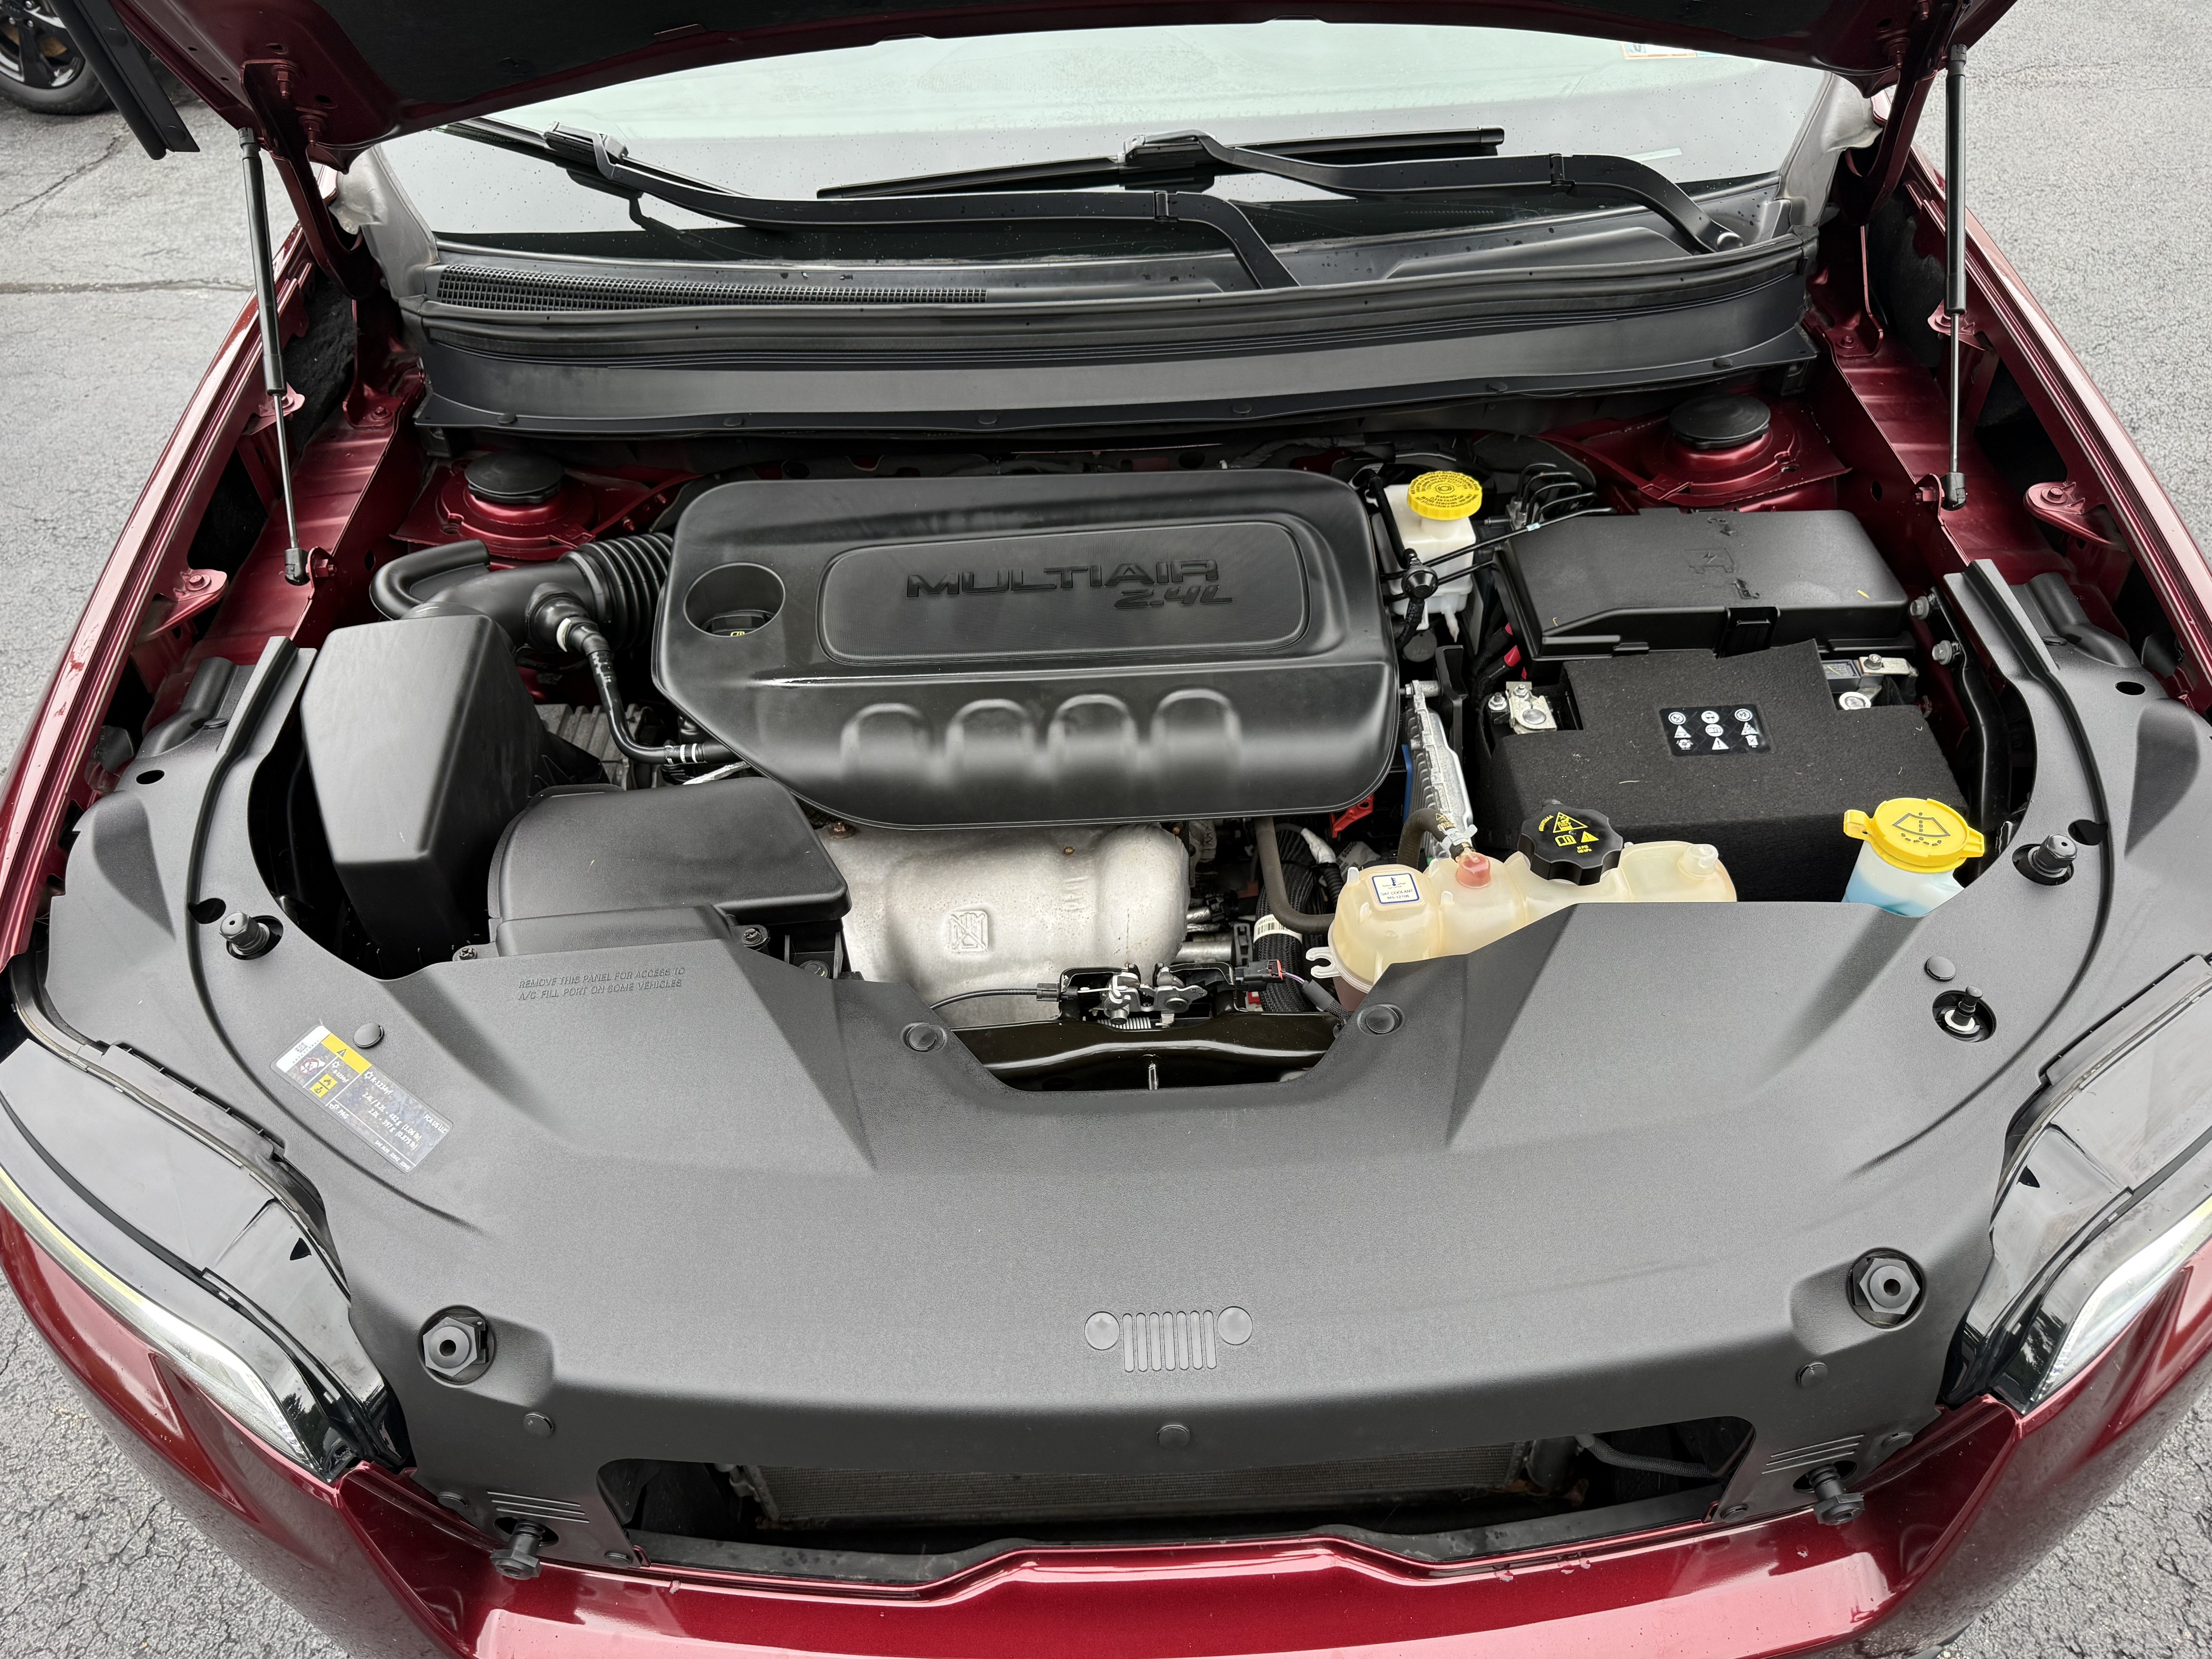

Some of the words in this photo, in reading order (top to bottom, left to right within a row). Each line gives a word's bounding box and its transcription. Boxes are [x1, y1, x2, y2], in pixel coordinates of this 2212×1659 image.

[907, 559, 1219, 598] MULTIAIR
[1114, 584, 1233, 608] 2.4L
[519, 978, 557, 988] REMOVE
[560, 976, 580, 985] THIS
[582, 973, 611, 983] PANEL
[614, 972, 632, 980] FOR
[634, 969, 670, 979] ACCESS
[518, 991, 536, 1001] A/C
[541, 989, 559, 998] FILL
[563, 987, 588, 997] PORT
[591, 985, 604, 994] ON
[607, 983, 634, 993] SOME
[638, 979, 682, 990] VEHICLES
[370, 1077, 394, 1095] R-1234yf
[338, 1109, 349, 1119] PAG
[362, 1092, 374, 1102] 2.4L
[374, 1102, 386, 1112] 3.2L
[389, 1113, 399, 1123] 482
[401, 1124, 415, 1136] (1.06
[413, 1132, 422, 1141] lb)
[423, 1114, 433, 1123] FCA
[437, 1125, 447, 1134] LLC
[368, 1108, 379, 1118] 2.0L
[382, 1119, 393, 1128] 397
[395, 1130, 412, 1145] (0.875
[409, 1142, 419, 1150] lb)
